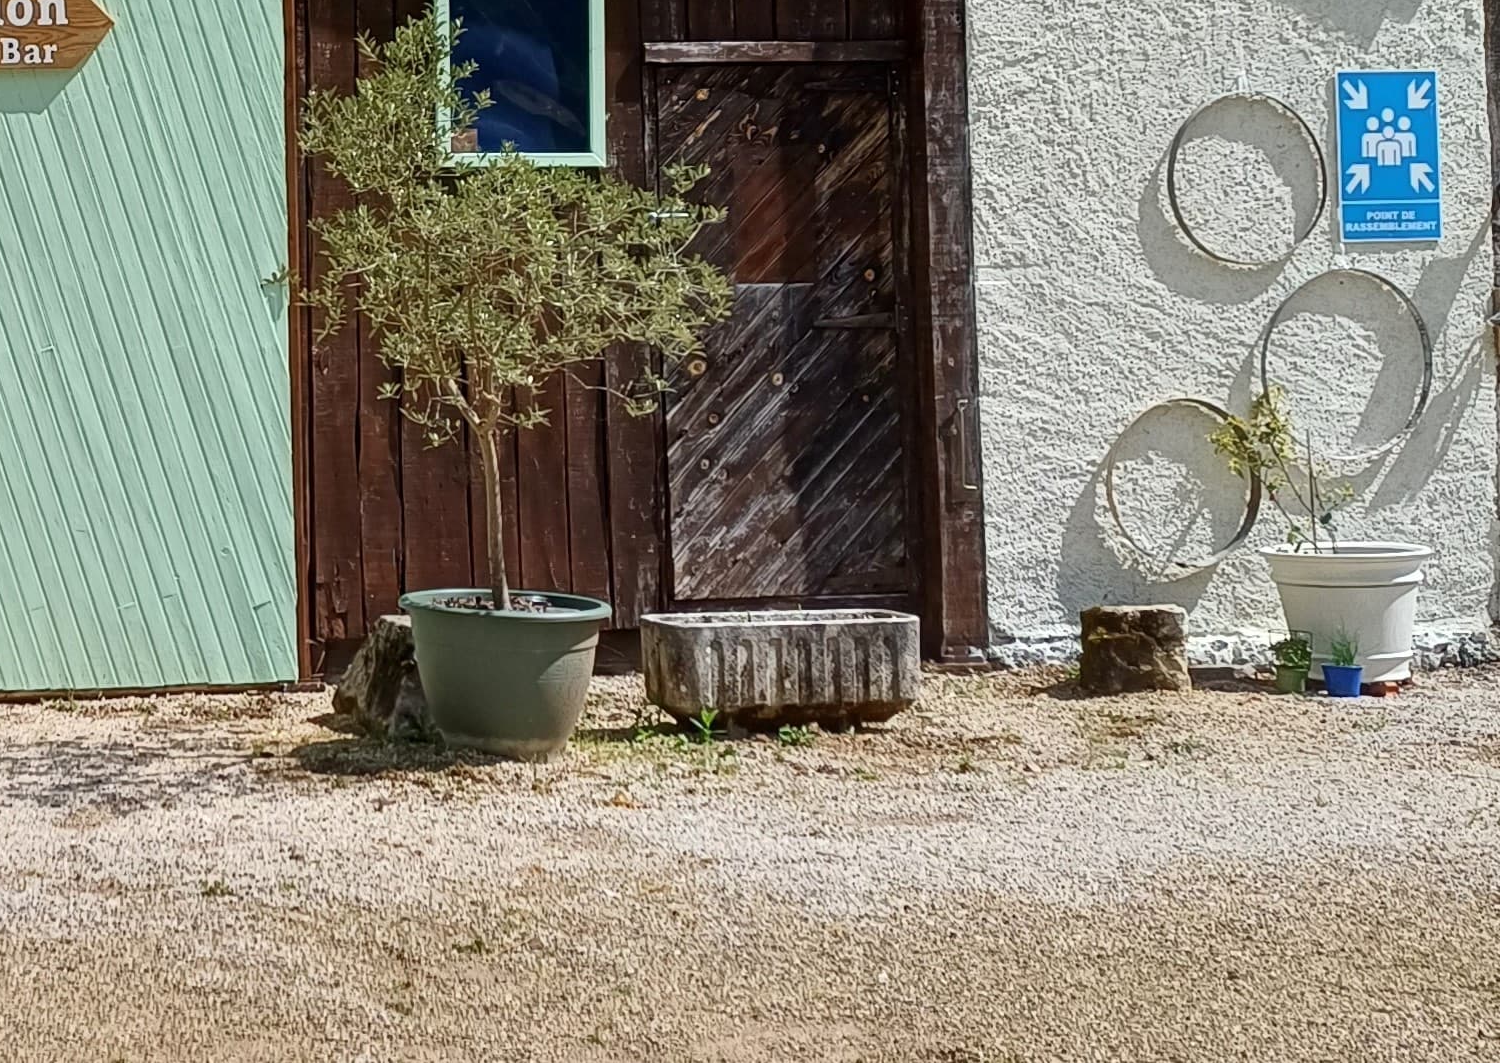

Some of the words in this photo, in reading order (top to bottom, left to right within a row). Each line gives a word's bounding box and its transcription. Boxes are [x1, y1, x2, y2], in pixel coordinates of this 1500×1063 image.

[0, 37, 58, 65] Bar
[1366, 211, 1399, 220] POINT
[1401, 210, 1416, 220] DE
[1345, 221, 1437, 232] RASSEMBLEMENT
